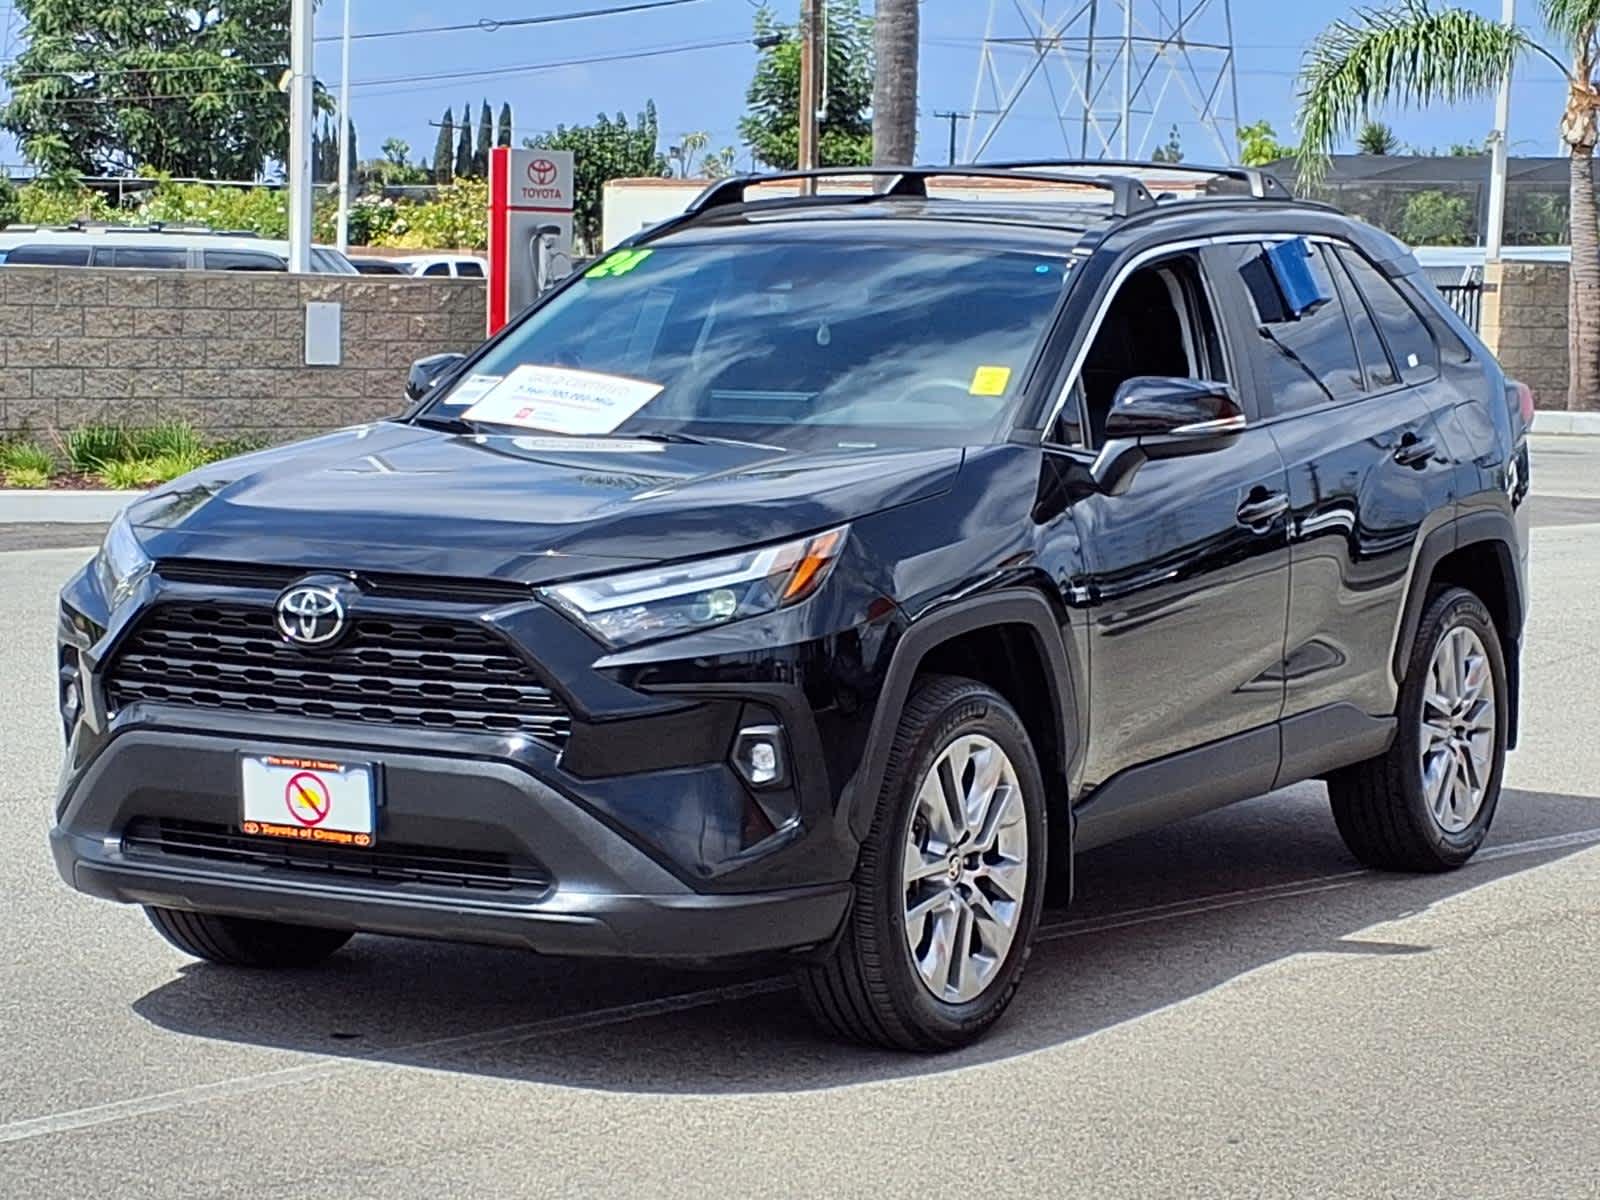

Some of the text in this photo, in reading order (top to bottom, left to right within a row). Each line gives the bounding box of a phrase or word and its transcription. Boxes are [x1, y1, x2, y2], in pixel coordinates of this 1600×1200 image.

[522, 187, 562, 199] TOYOTA
[260, 823, 353, 844] Toyota of Orange
